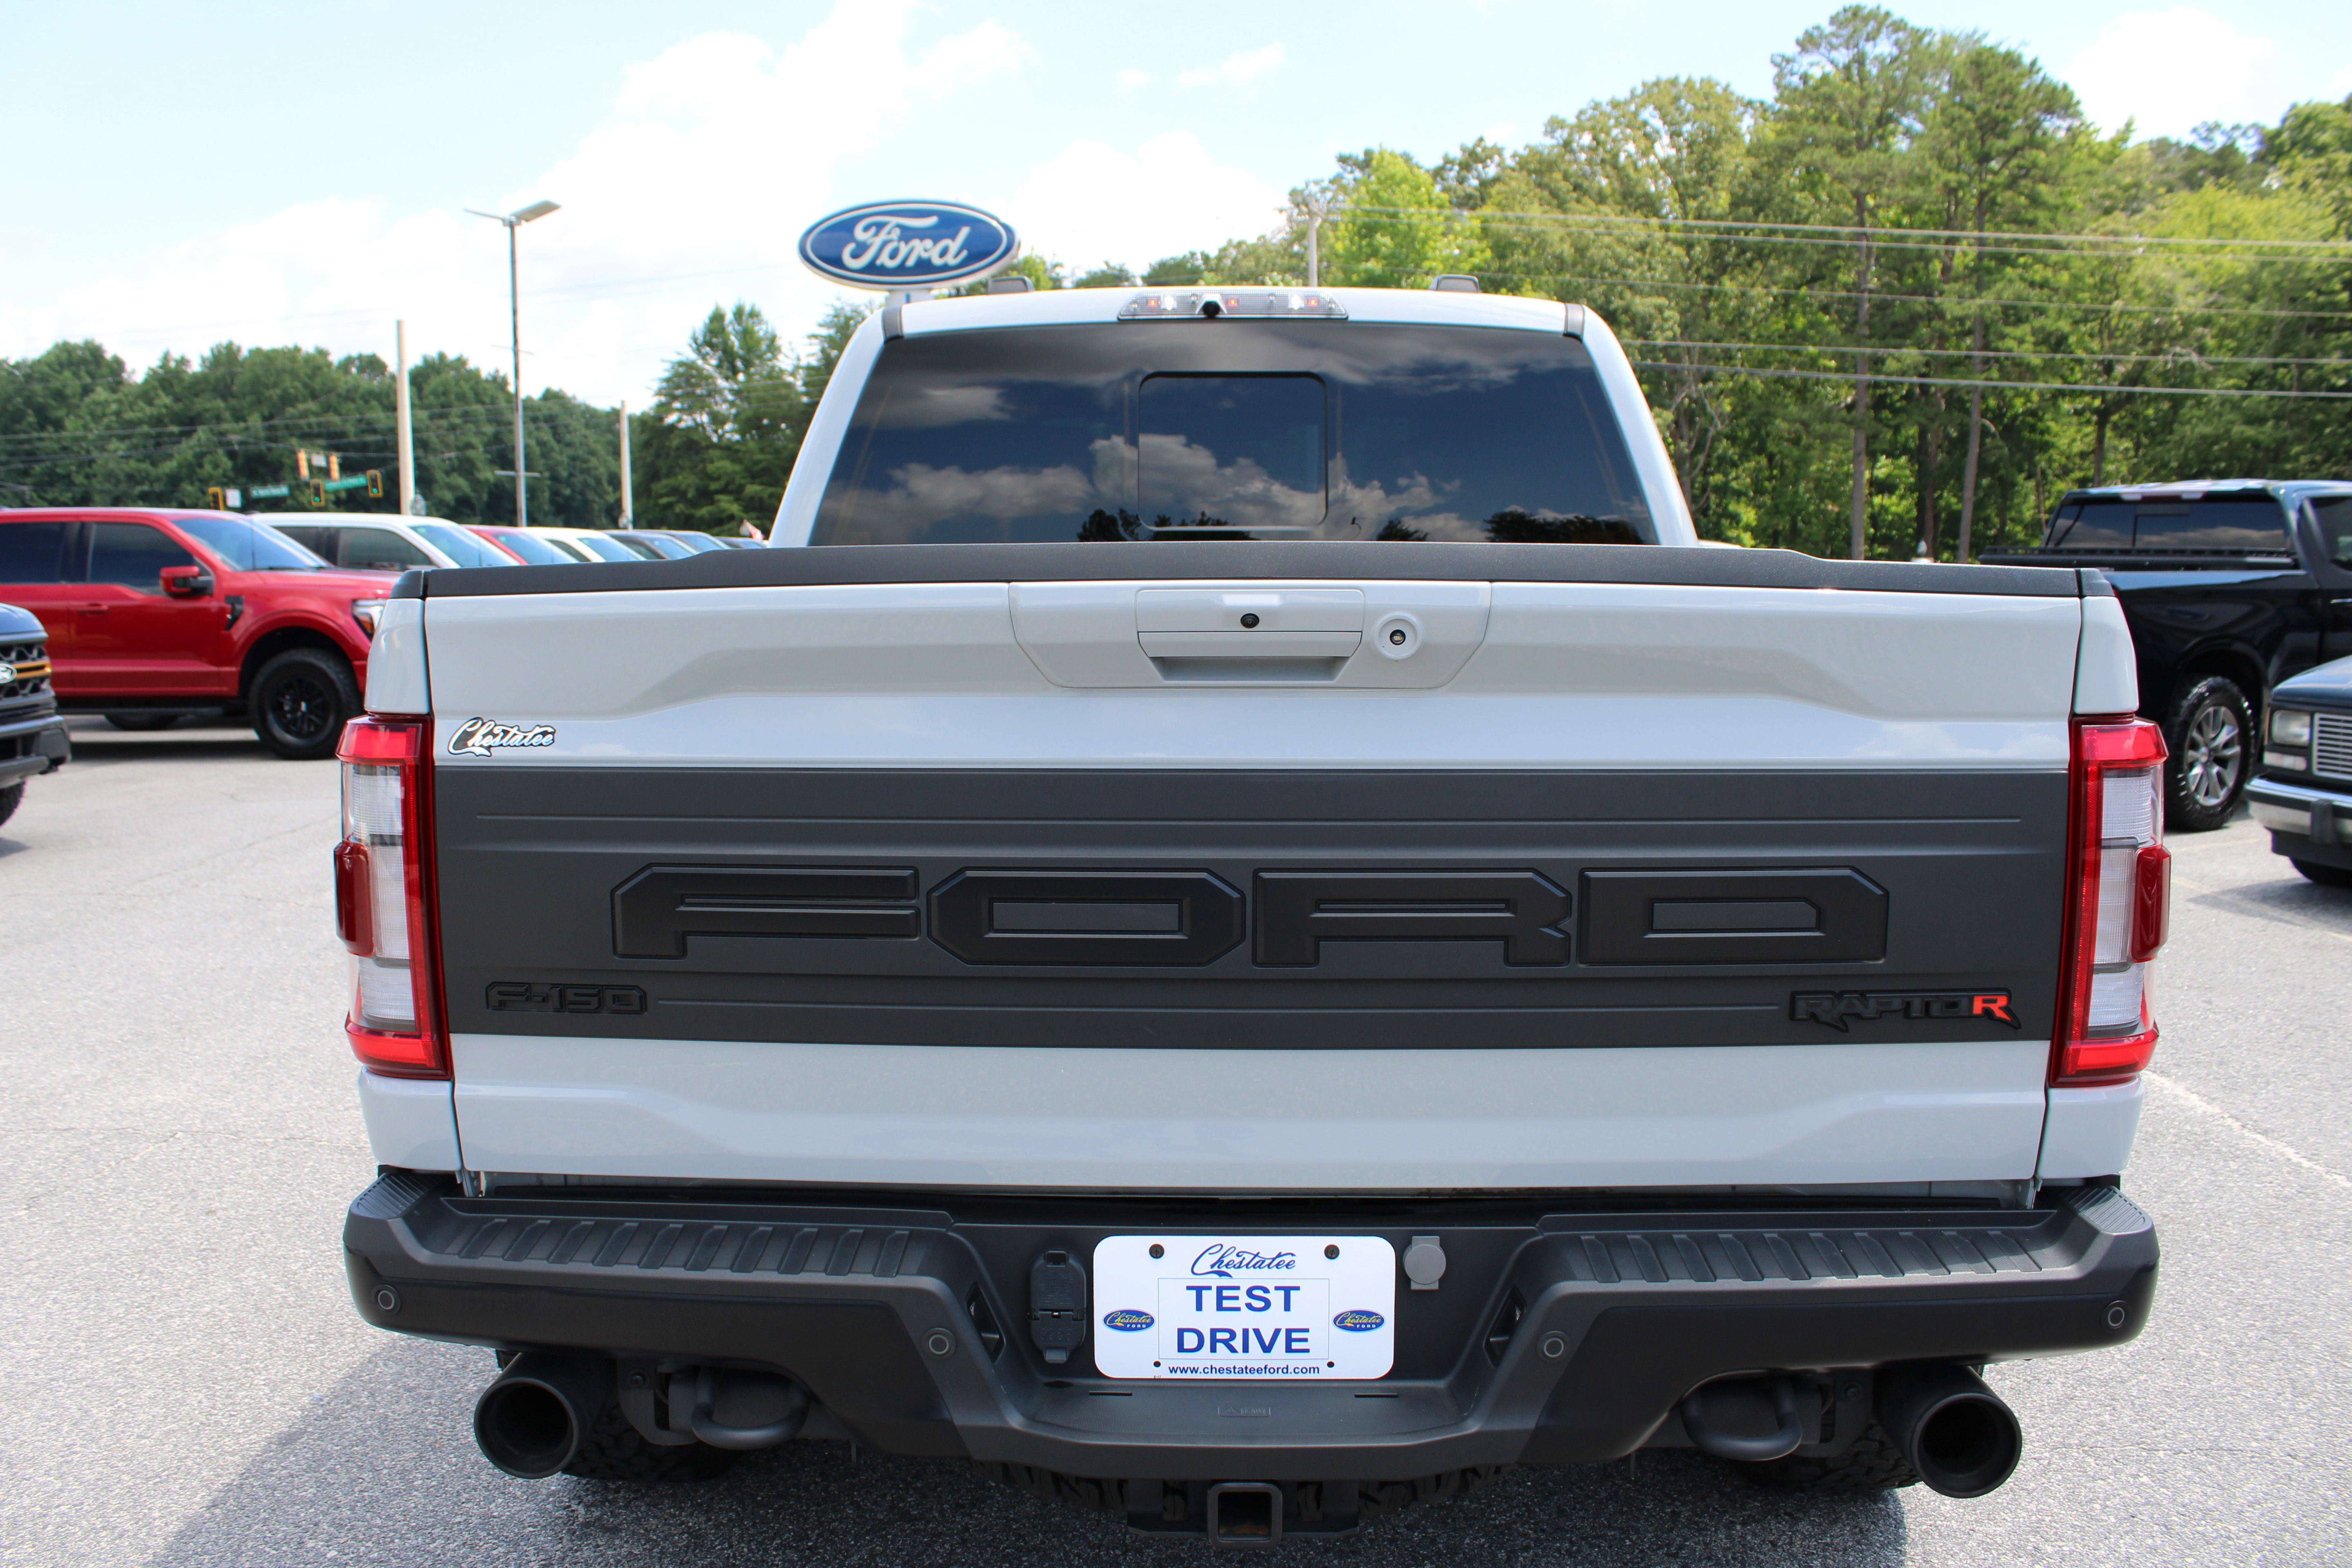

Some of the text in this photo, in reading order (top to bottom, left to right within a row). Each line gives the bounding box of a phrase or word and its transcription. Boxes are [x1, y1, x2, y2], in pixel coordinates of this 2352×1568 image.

[842, 215, 971, 270] Ford
[448, 718, 555, 757] Chestatee
[611, 863, 1889, 967] FORD
[485, 982, 648, 1015] F-150
[1790, 988, 2021, 1032] RAPTOR
[1191, 1243, 1297, 1278] Chestatee
[1186, 1285, 1301, 1312] TEST
[1106, 1312, 1151, 1327] Chestatee
[1336, 1312, 1381, 1327] Chestatee
[1177, 1328, 1310, 1353] DRIVE
[1168, 1364, 1320, 1374] www.chestateeford.com
